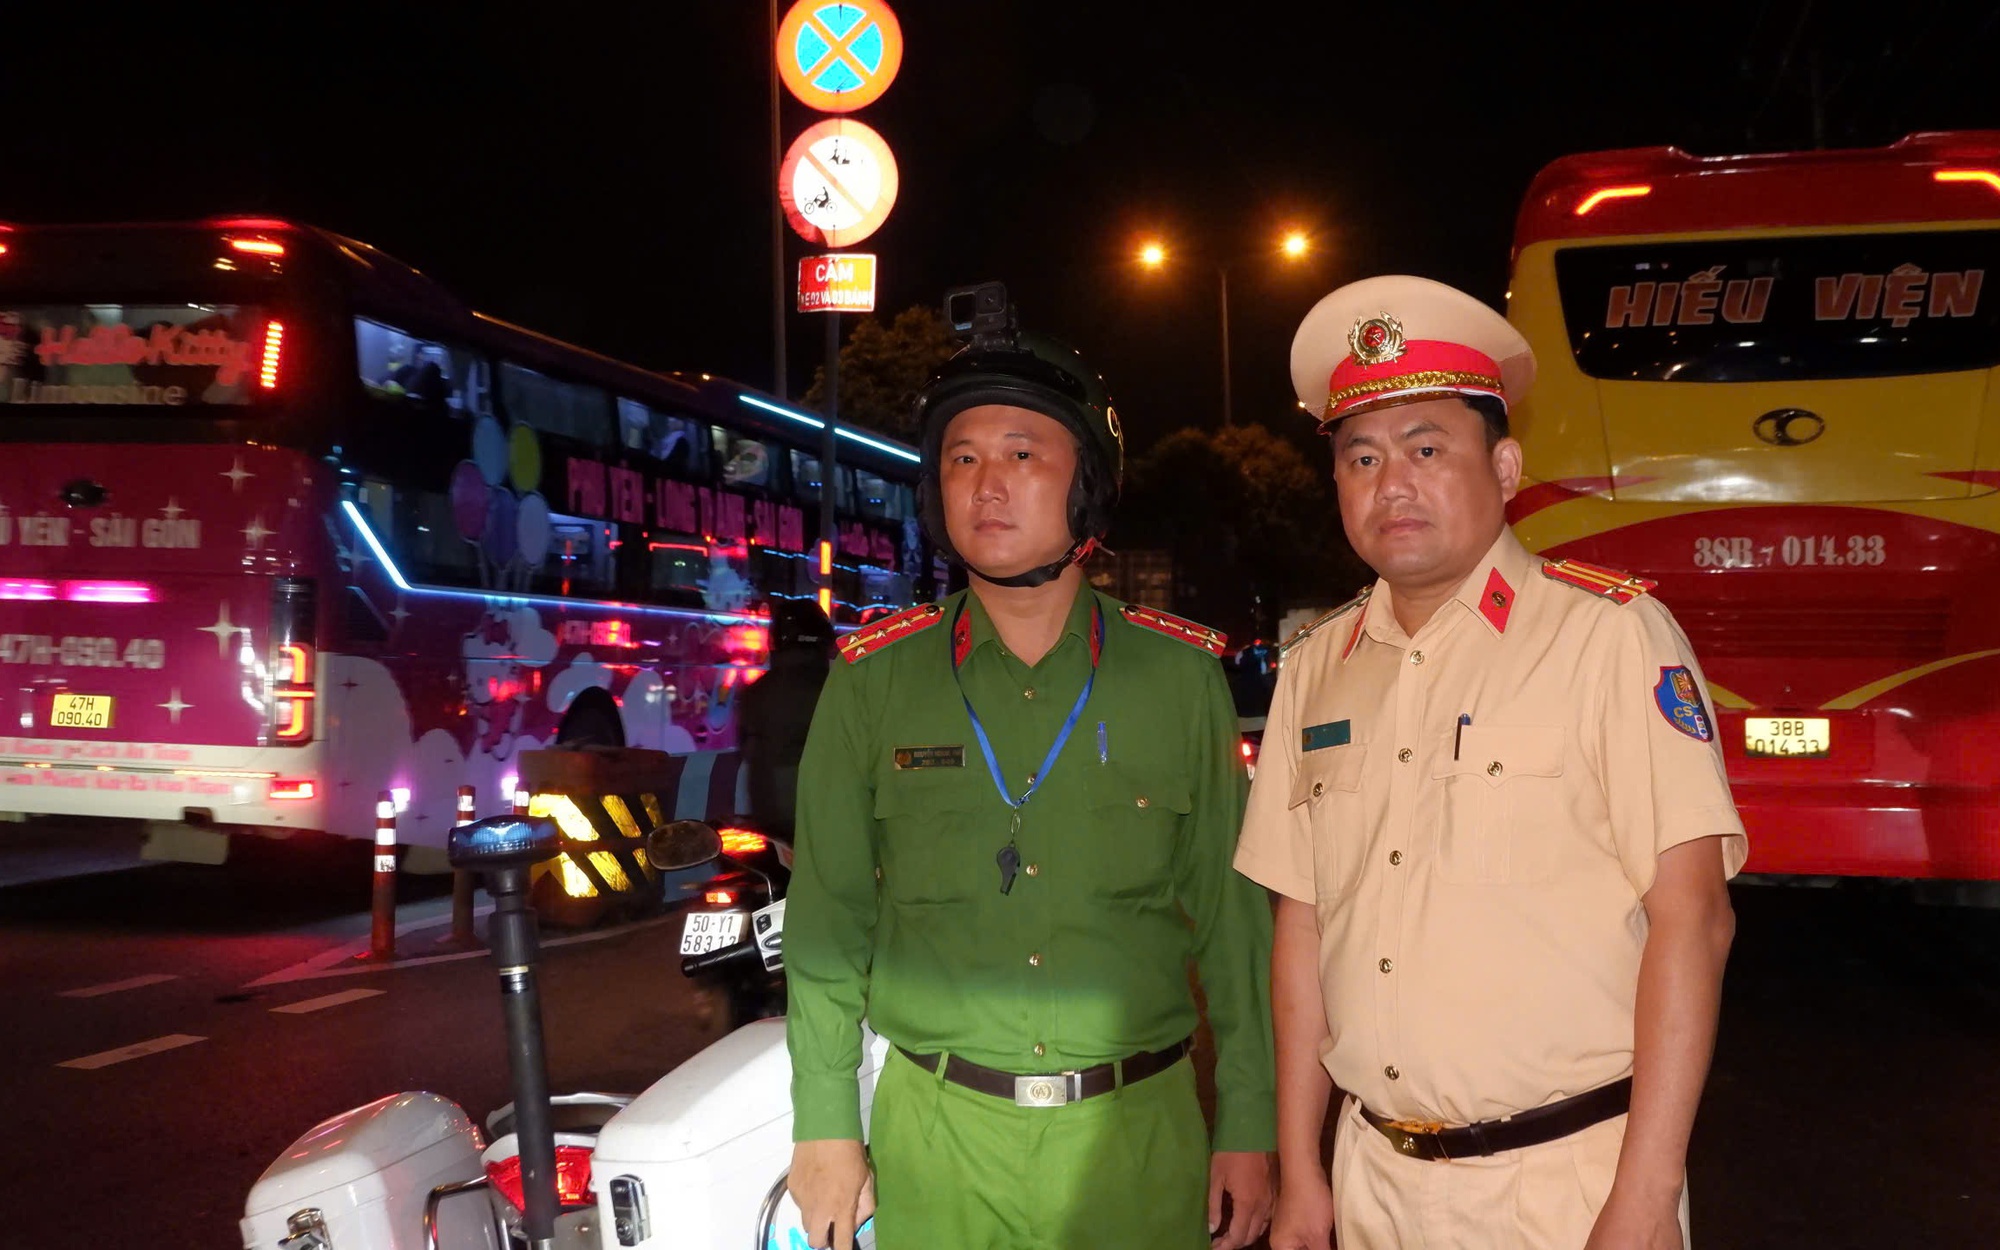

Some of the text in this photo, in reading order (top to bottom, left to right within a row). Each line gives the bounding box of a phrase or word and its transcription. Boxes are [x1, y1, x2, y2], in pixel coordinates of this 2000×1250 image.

[1605, 263, 1985, 328] HIẾU VIỆN
[1694, 537, 1754, 568] 38B
[1782, 534, 1886, 566] 014.33
[70, 696, 94, 710] 47H
[57, 711, 102, 726] 090.40
[1769, 721, 1804, 736] 38B
[1754, 739, 1820, 756] 014.33
[692, 915, 734, 933] 50-Y1
